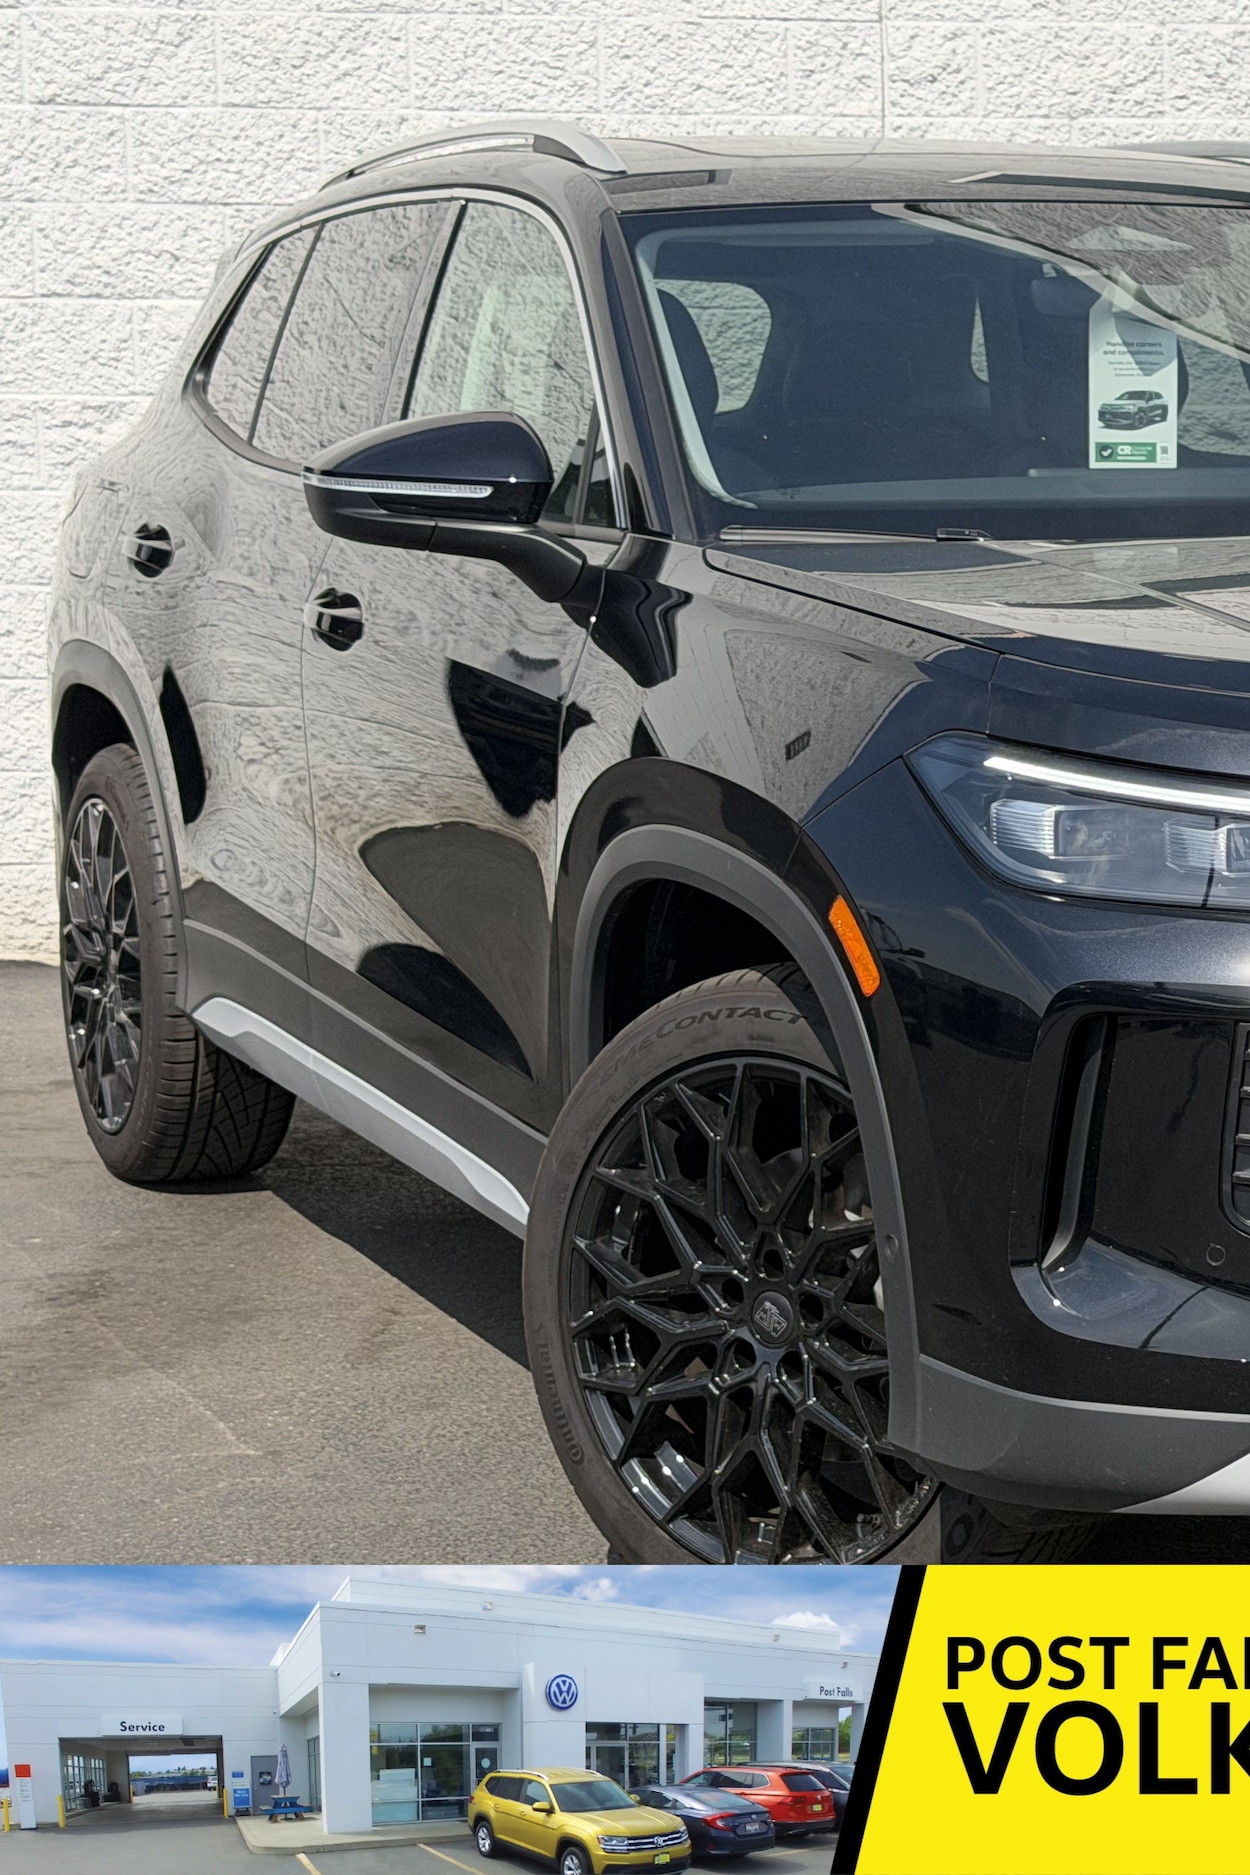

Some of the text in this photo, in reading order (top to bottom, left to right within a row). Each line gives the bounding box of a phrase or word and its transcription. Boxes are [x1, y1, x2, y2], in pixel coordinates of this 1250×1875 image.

[819, 1686, 853, 1697] Post Falls
[120, 1721, 165, 1732] Service
